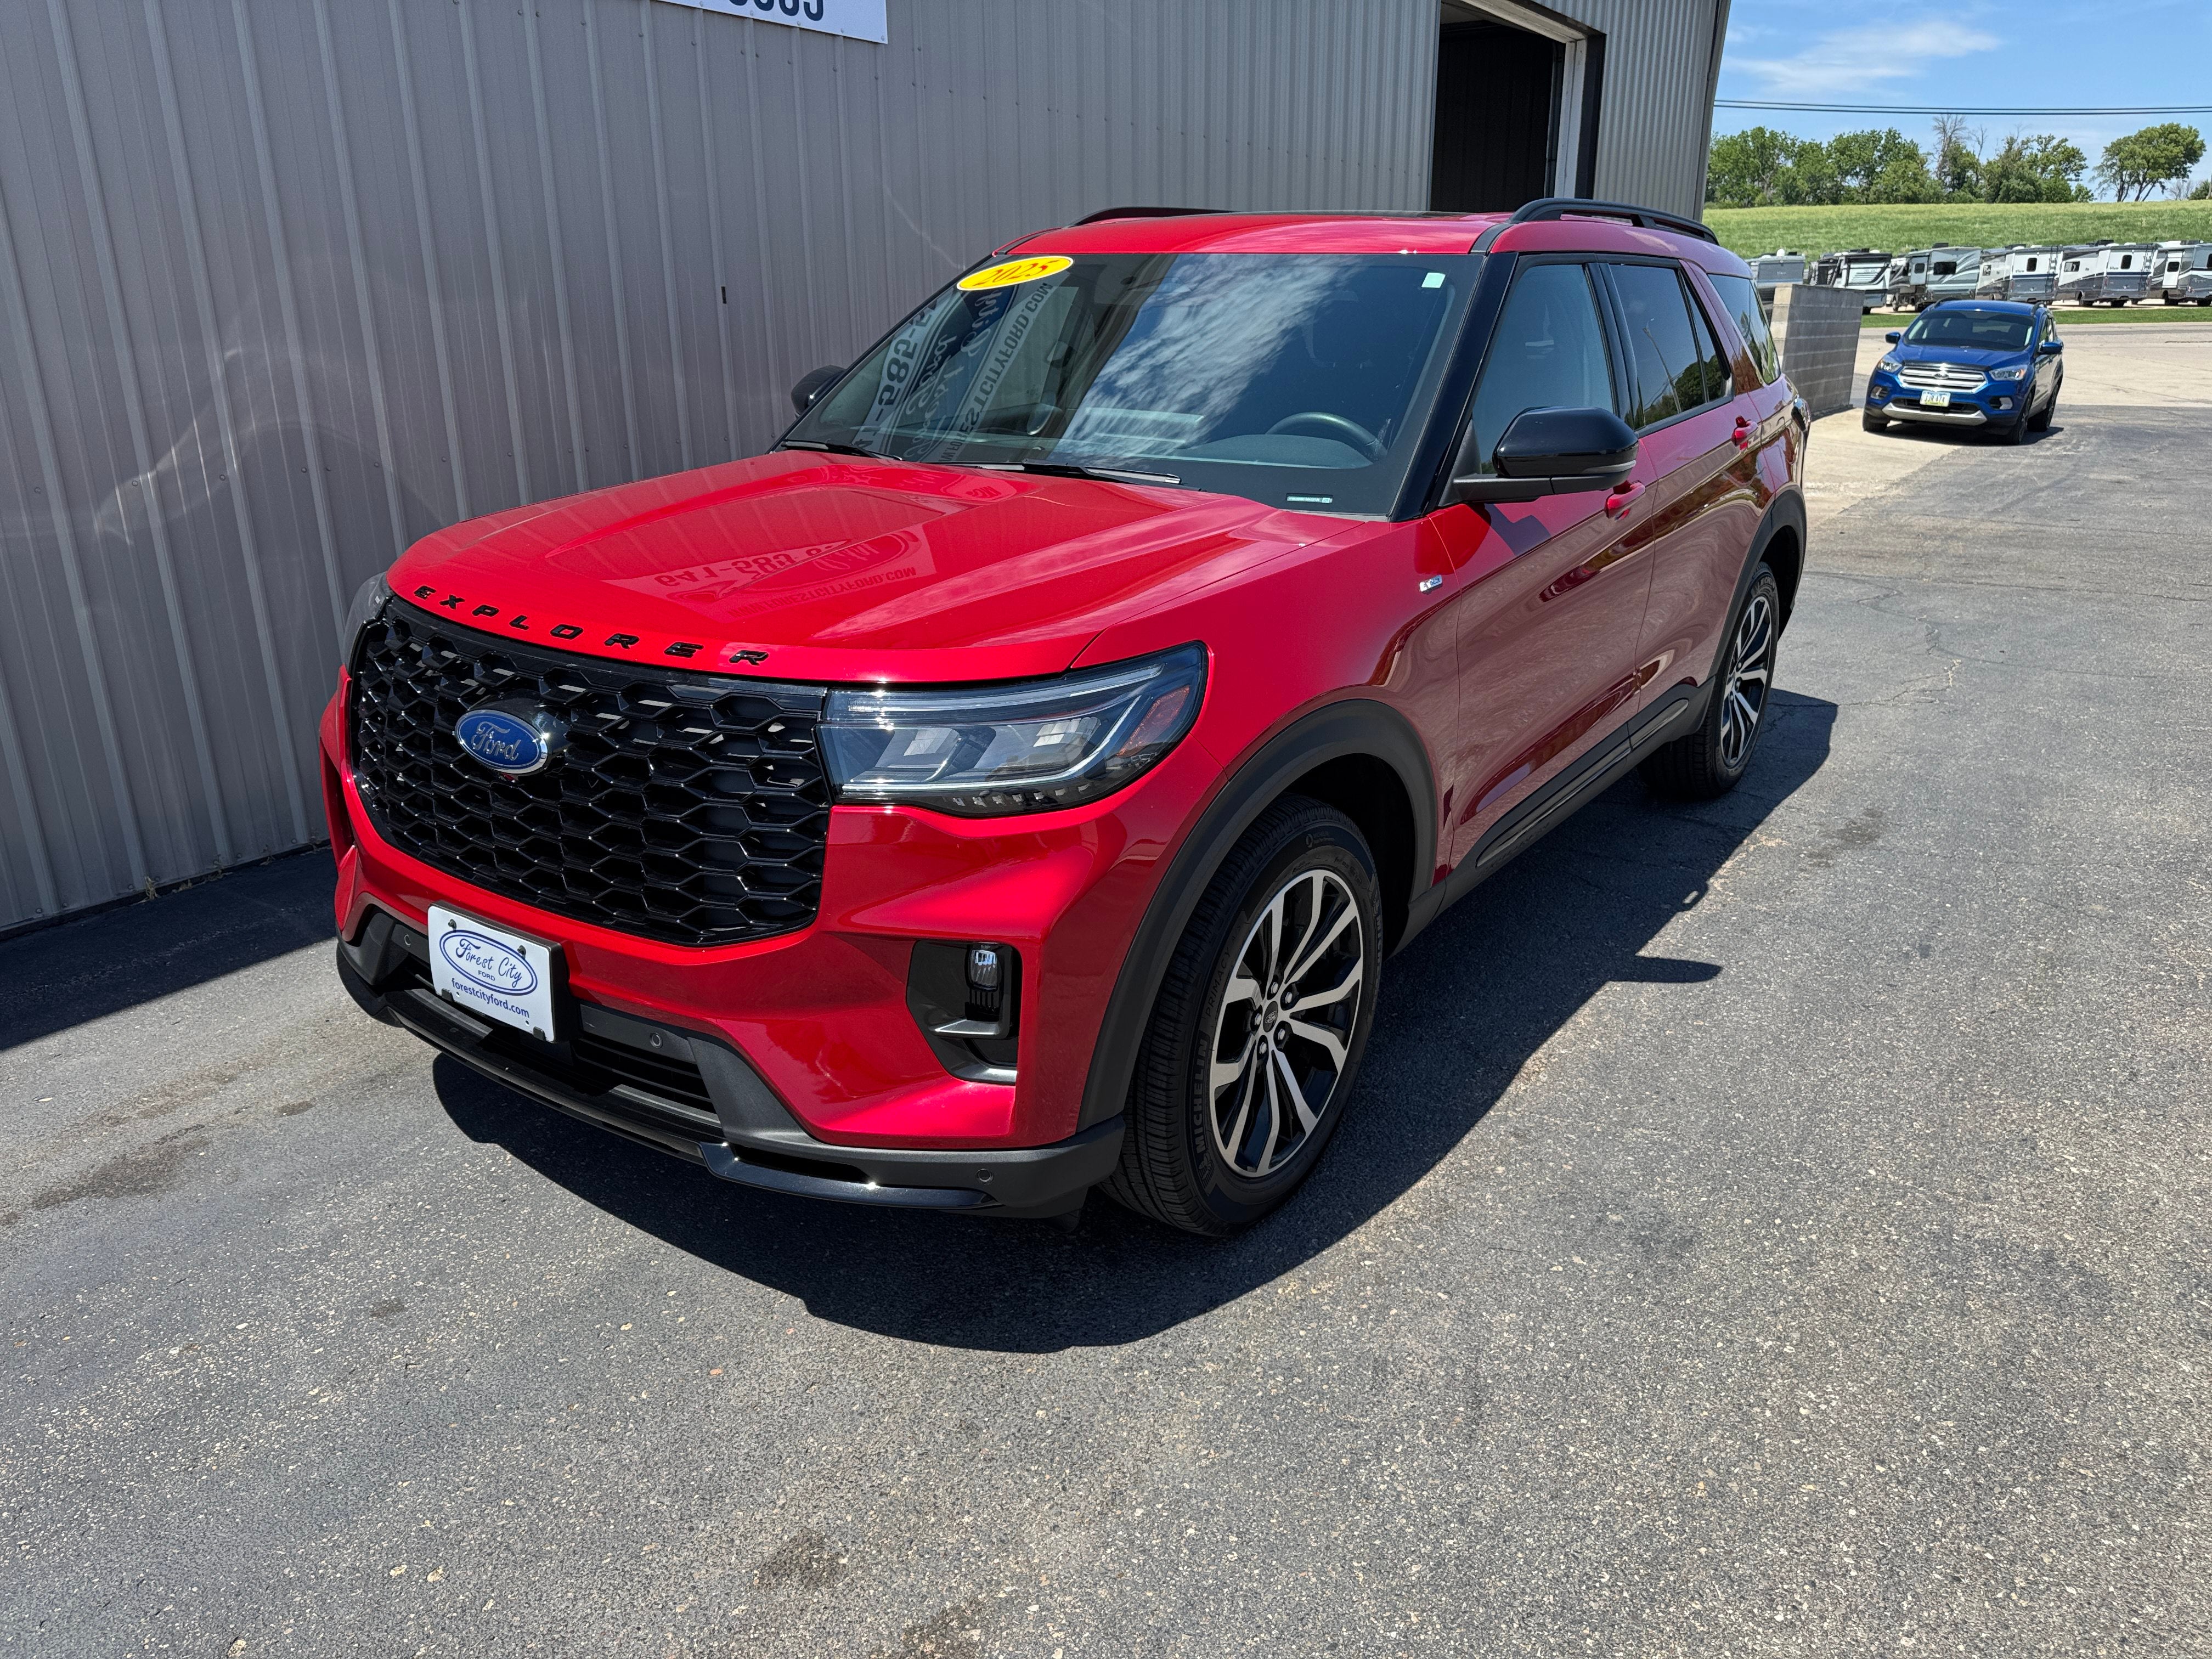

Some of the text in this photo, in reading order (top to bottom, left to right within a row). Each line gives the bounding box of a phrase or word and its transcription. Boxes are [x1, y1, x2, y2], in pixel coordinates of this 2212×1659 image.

[970, 259, 1060, 287] 2025
[413, 585, 769, 666] EXPLORER
[471, 720, 522, 761] Ford
[455, 938, 522, 988] Forest City
[478, 970, 495, 981] FORD
[1205, 947, 1231, 1018] PRIMACY
[451, 978, 530, 1019] forestcityford.com
[1193, 1039, 1209, 1154] MICHELIN
